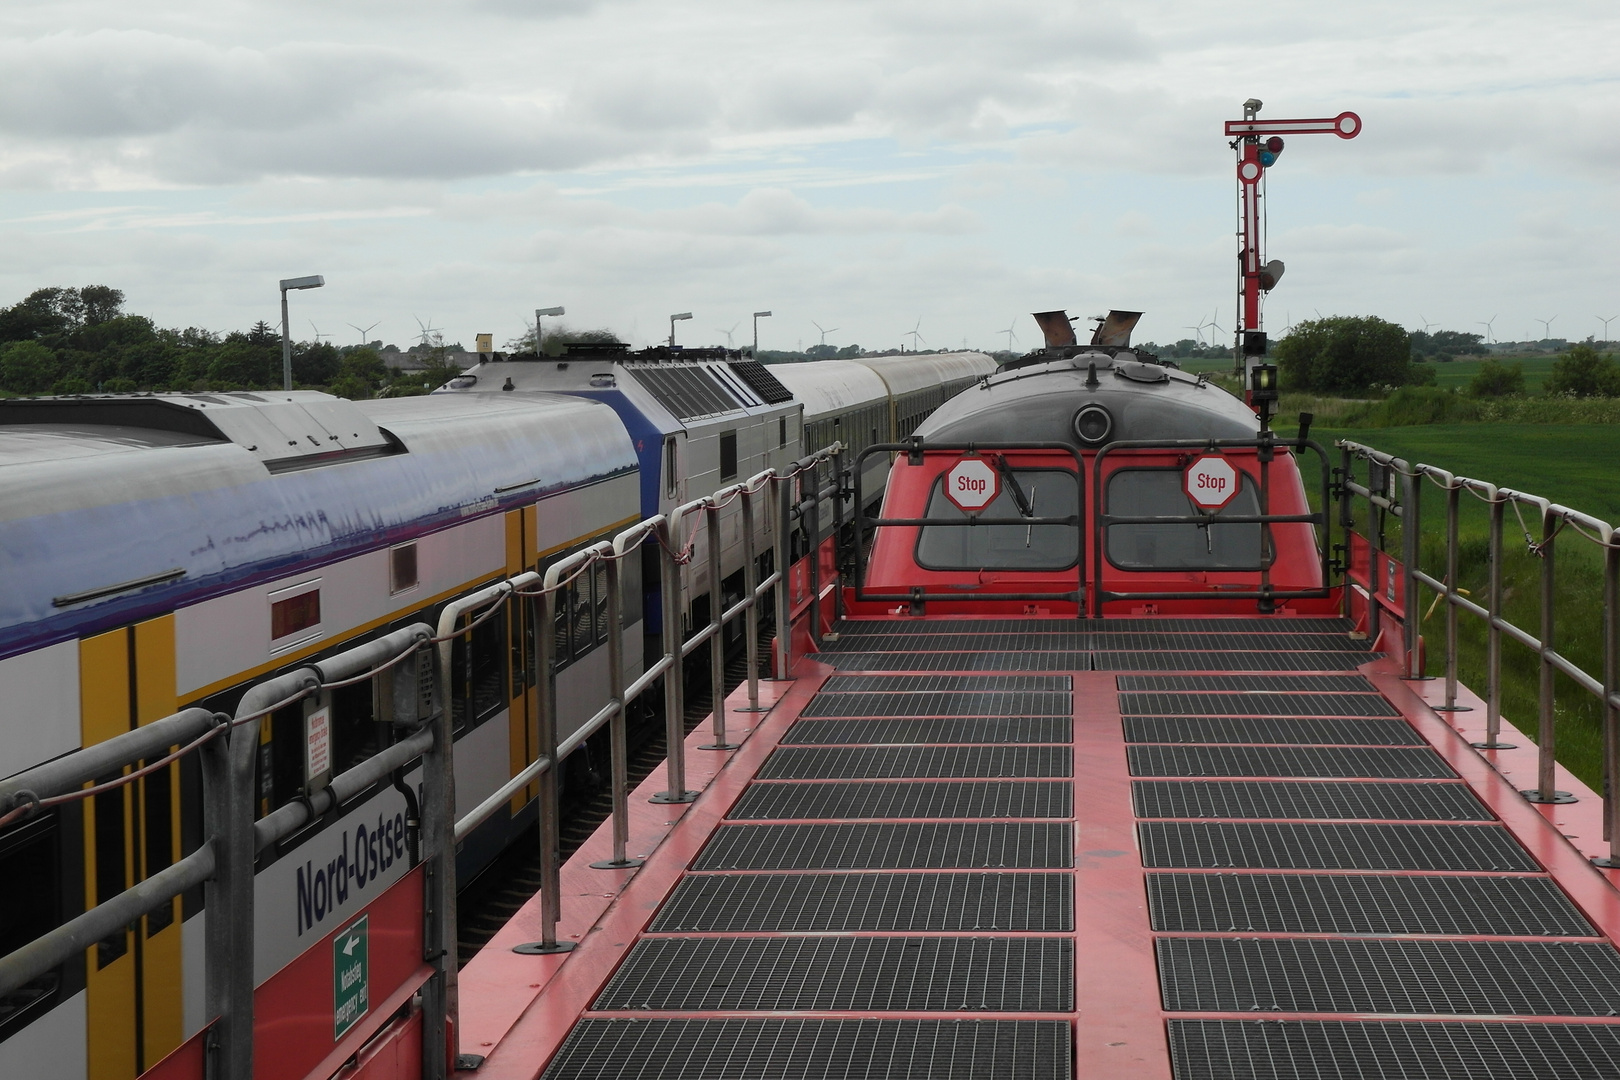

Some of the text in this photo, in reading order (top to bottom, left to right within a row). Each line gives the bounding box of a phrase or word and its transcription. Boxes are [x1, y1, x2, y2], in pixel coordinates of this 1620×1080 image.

[958, 475, 986, 495] Stop
[1197, 473, 1226, 493] Stop
[341, 960, 362, 993] Notabstieg
[336, 980, 367, 1026] emergency exit
